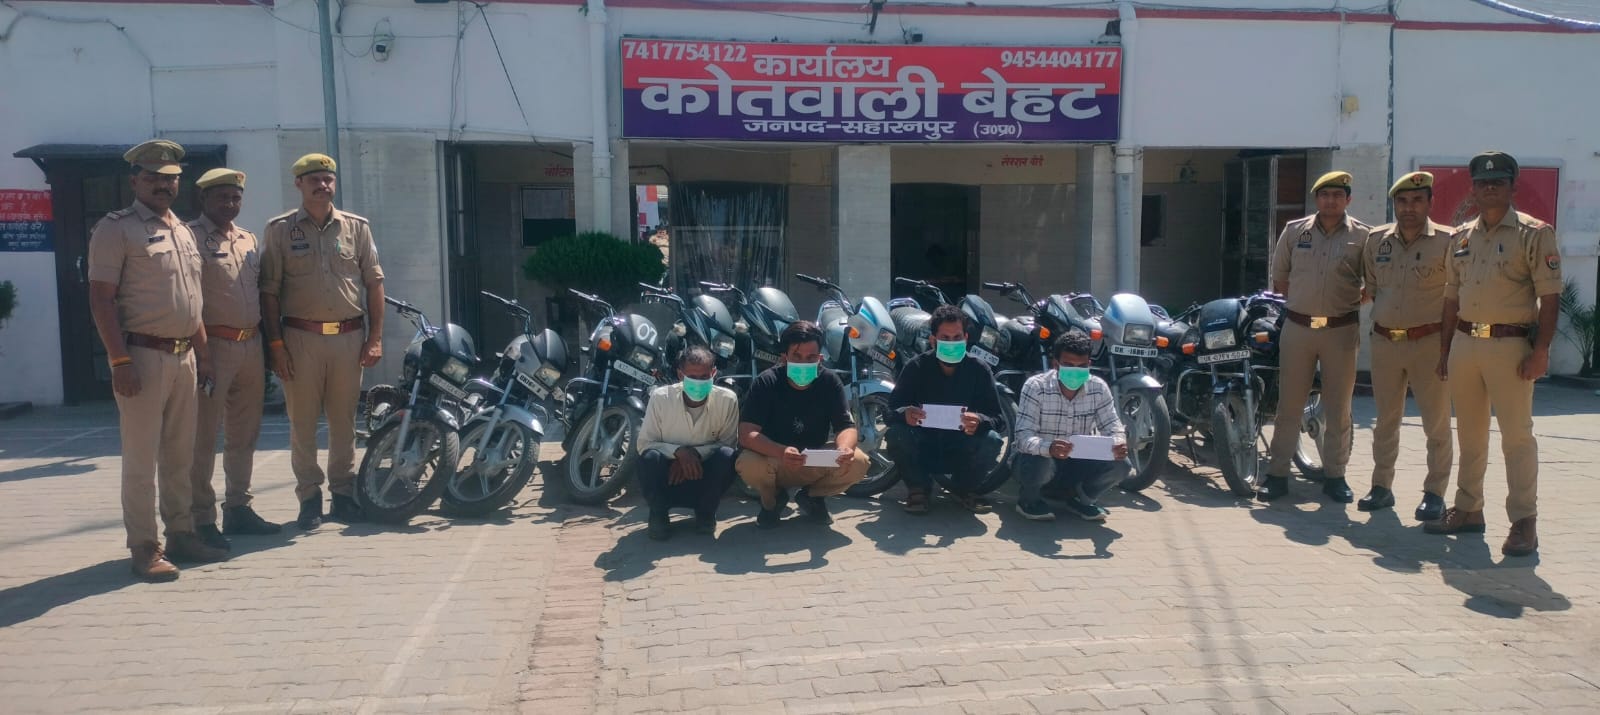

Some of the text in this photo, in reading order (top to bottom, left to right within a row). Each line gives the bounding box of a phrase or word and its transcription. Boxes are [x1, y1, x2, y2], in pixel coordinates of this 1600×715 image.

[623, 41, 747, 62] 7417754122
[752, 47, 892, 78] कार्यालय
[1001, 50, 1118, 68] 9454404177
[638, 64, 1105, 122] कोतवाली बेहट
[637, 323, 657, 346] 07
